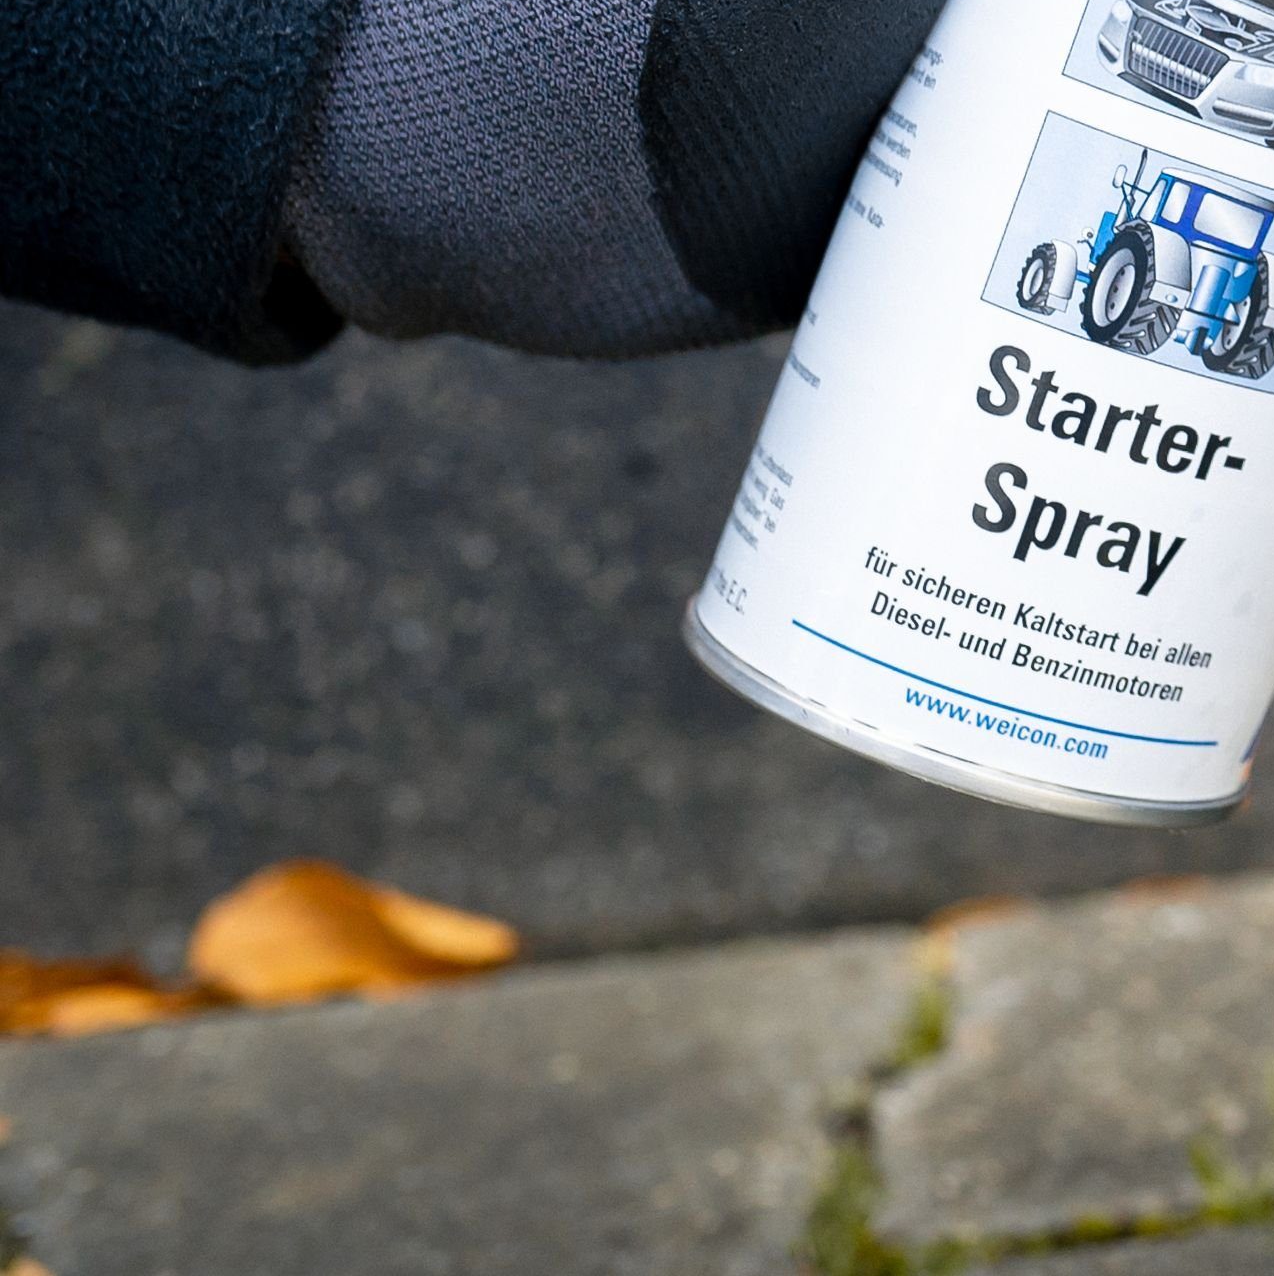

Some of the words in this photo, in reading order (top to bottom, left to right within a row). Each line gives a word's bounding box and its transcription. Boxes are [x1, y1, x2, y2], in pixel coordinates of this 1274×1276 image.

[976, 345, 1247, 482] Starter-
[972, 462, 1187, 598] Spray
[864, 546, 898, 581] für
[902, 564, 1008, 621] sicheren
[1013, 603, 1120, 654] Kaltstart
[1125, 632, 1162, 662] bei
[1165, 644, 1213, 670] allen
[870, 591, 952, 641] Diesel-
[958, 630, 1006, 663] und
[1012, 643, 1184, 704] Benzinmotoren
[904, 687, 1109, 761] www.weicon.com
